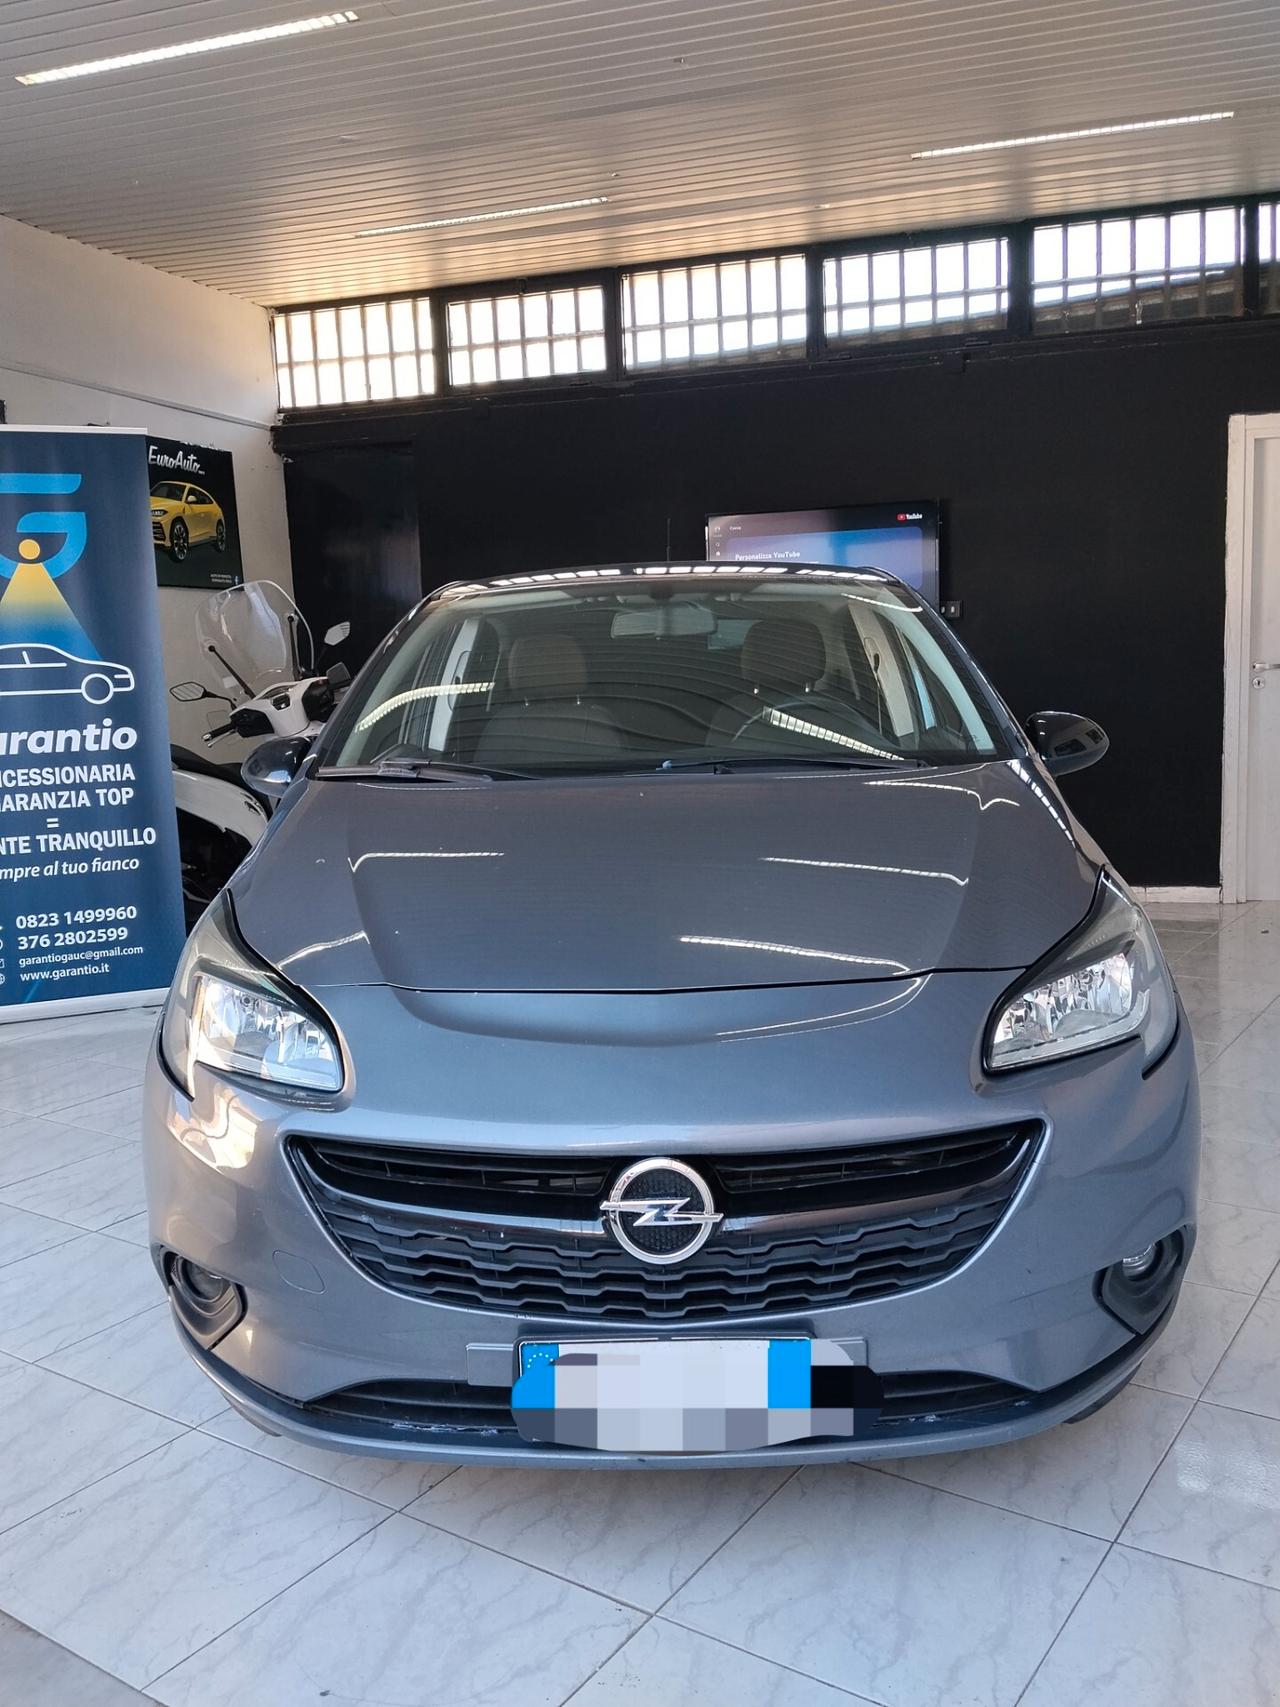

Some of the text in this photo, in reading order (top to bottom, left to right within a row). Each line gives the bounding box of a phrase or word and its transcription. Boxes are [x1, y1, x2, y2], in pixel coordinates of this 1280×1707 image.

[148, 445, 200, 473] EuroAuto
[774, 551, 801, 559] YouTube
[0, 763, 136, 788] CESSIONARIA
[0, 787, 134, 812] ARANZIA TOP
[36, 827, 157, 852] TRANQUILLO
[43, 861, 59, 876] al
[61, 861, 89, 875] tuo
[91, 857, 140, 873] fianco
[16, 905, 137, 929] 0823 1499960
[18, 926, 128, 950] 376 2802599
[19, 945, 143, 968] garantiogauc@gmail.com
[20, 963, 110, 982] www.garantio.it
